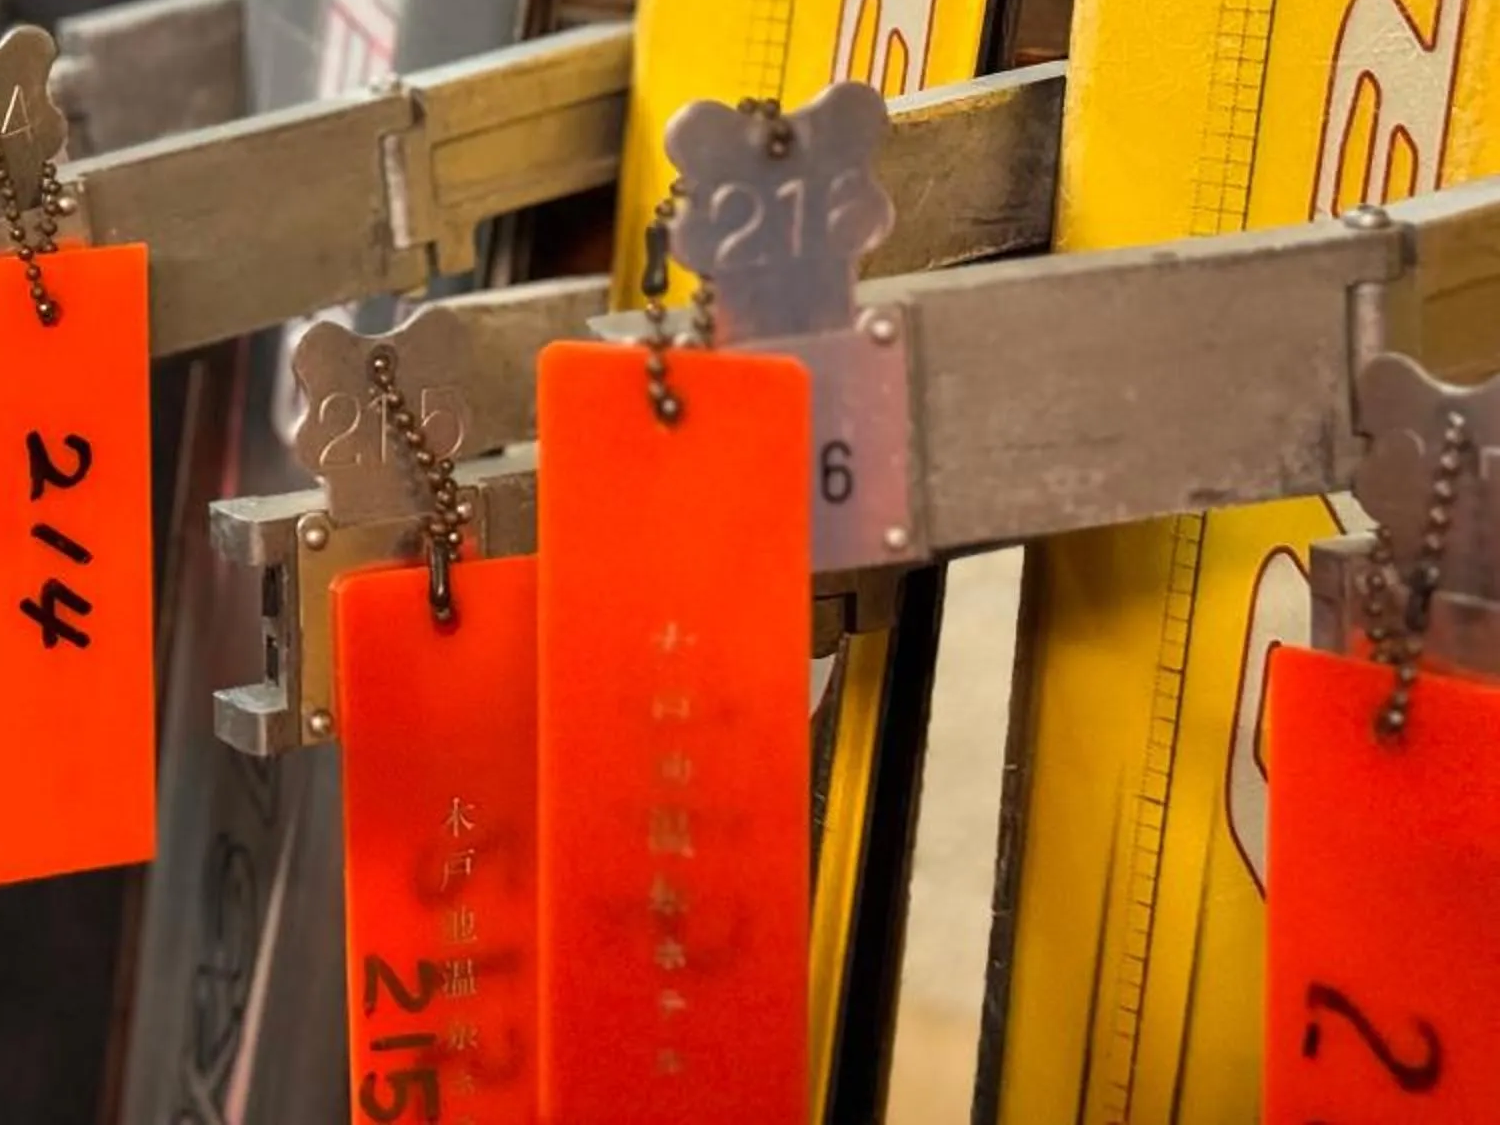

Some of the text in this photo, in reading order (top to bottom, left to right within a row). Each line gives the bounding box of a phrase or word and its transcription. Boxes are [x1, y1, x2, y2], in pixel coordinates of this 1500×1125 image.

[20, 430, 93, 650] 214
[819, 440, 853, 504] 6
[359, 954, 440, 1125] 215
